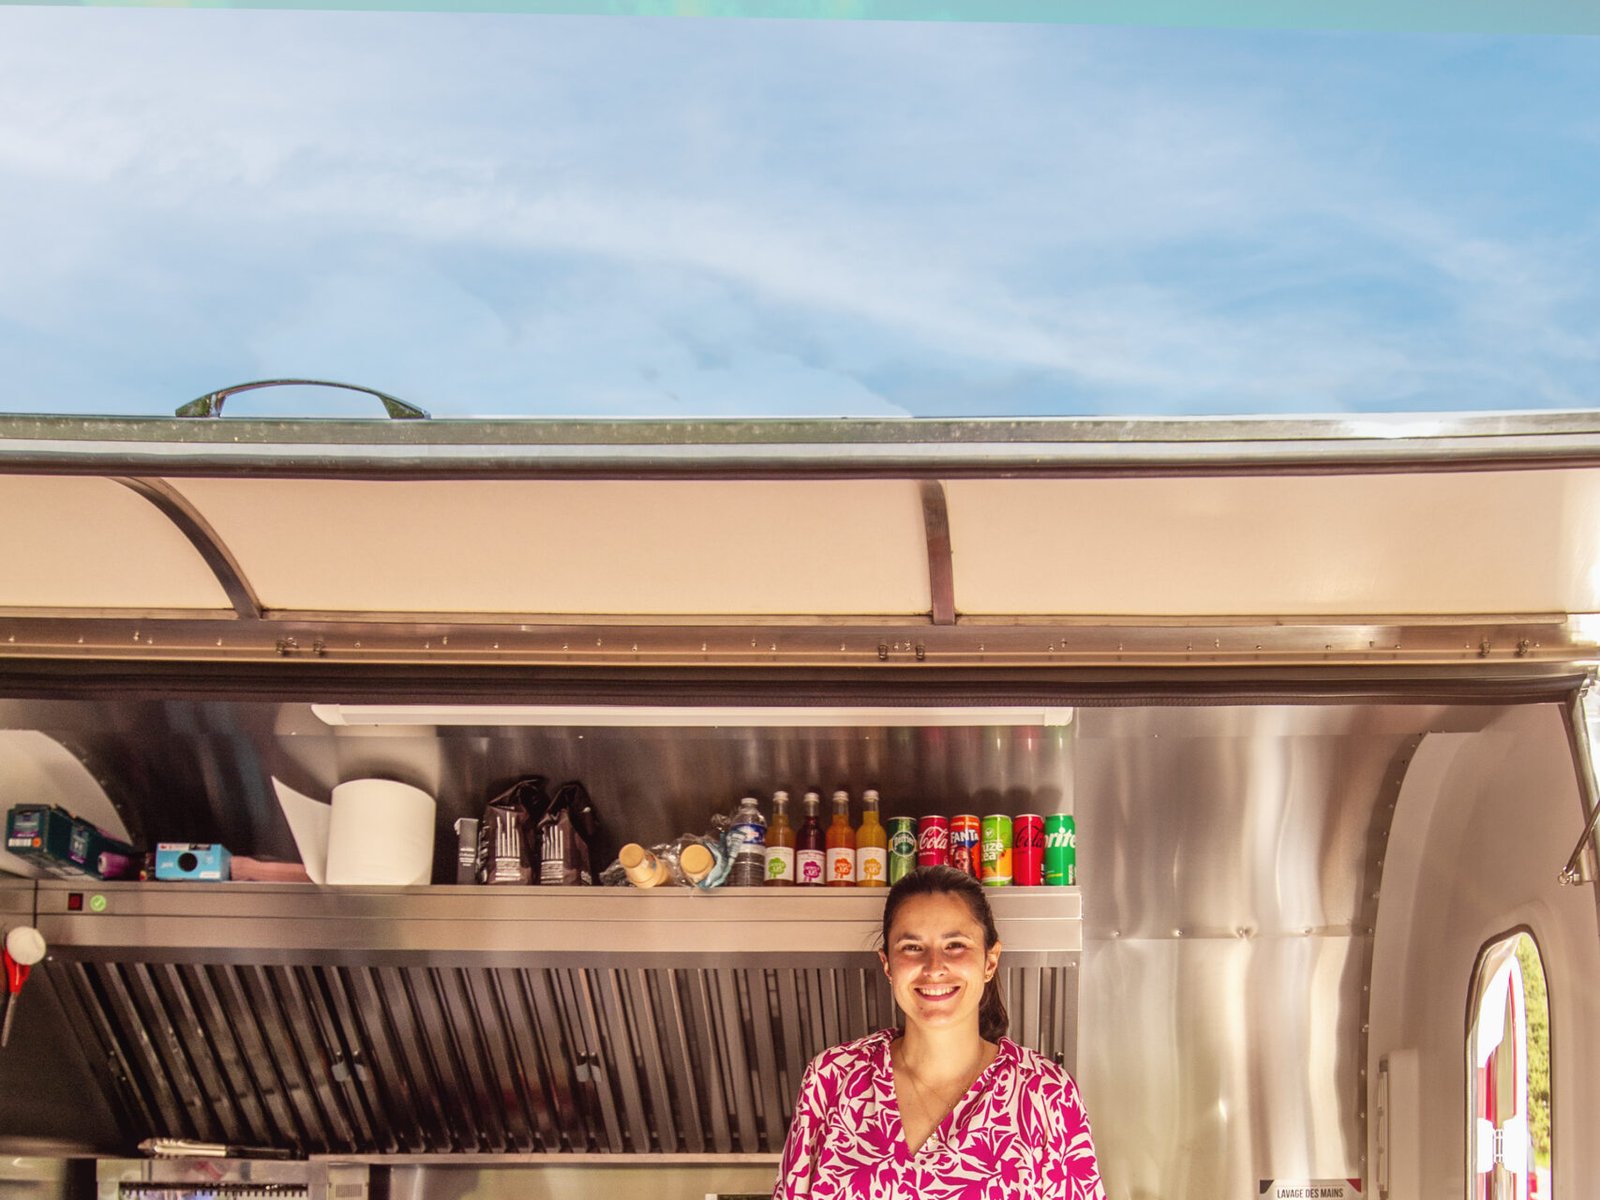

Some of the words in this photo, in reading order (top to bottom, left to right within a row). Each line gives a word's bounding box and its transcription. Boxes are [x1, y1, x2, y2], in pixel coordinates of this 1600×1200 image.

[951, 829, 979, 844] FANTA
[1277, 1189, 1303, 1199] LAVAGE
[1305, 1188, 1319, 1198] DES
[1320, 1188, 1344, 1198] MAINS
